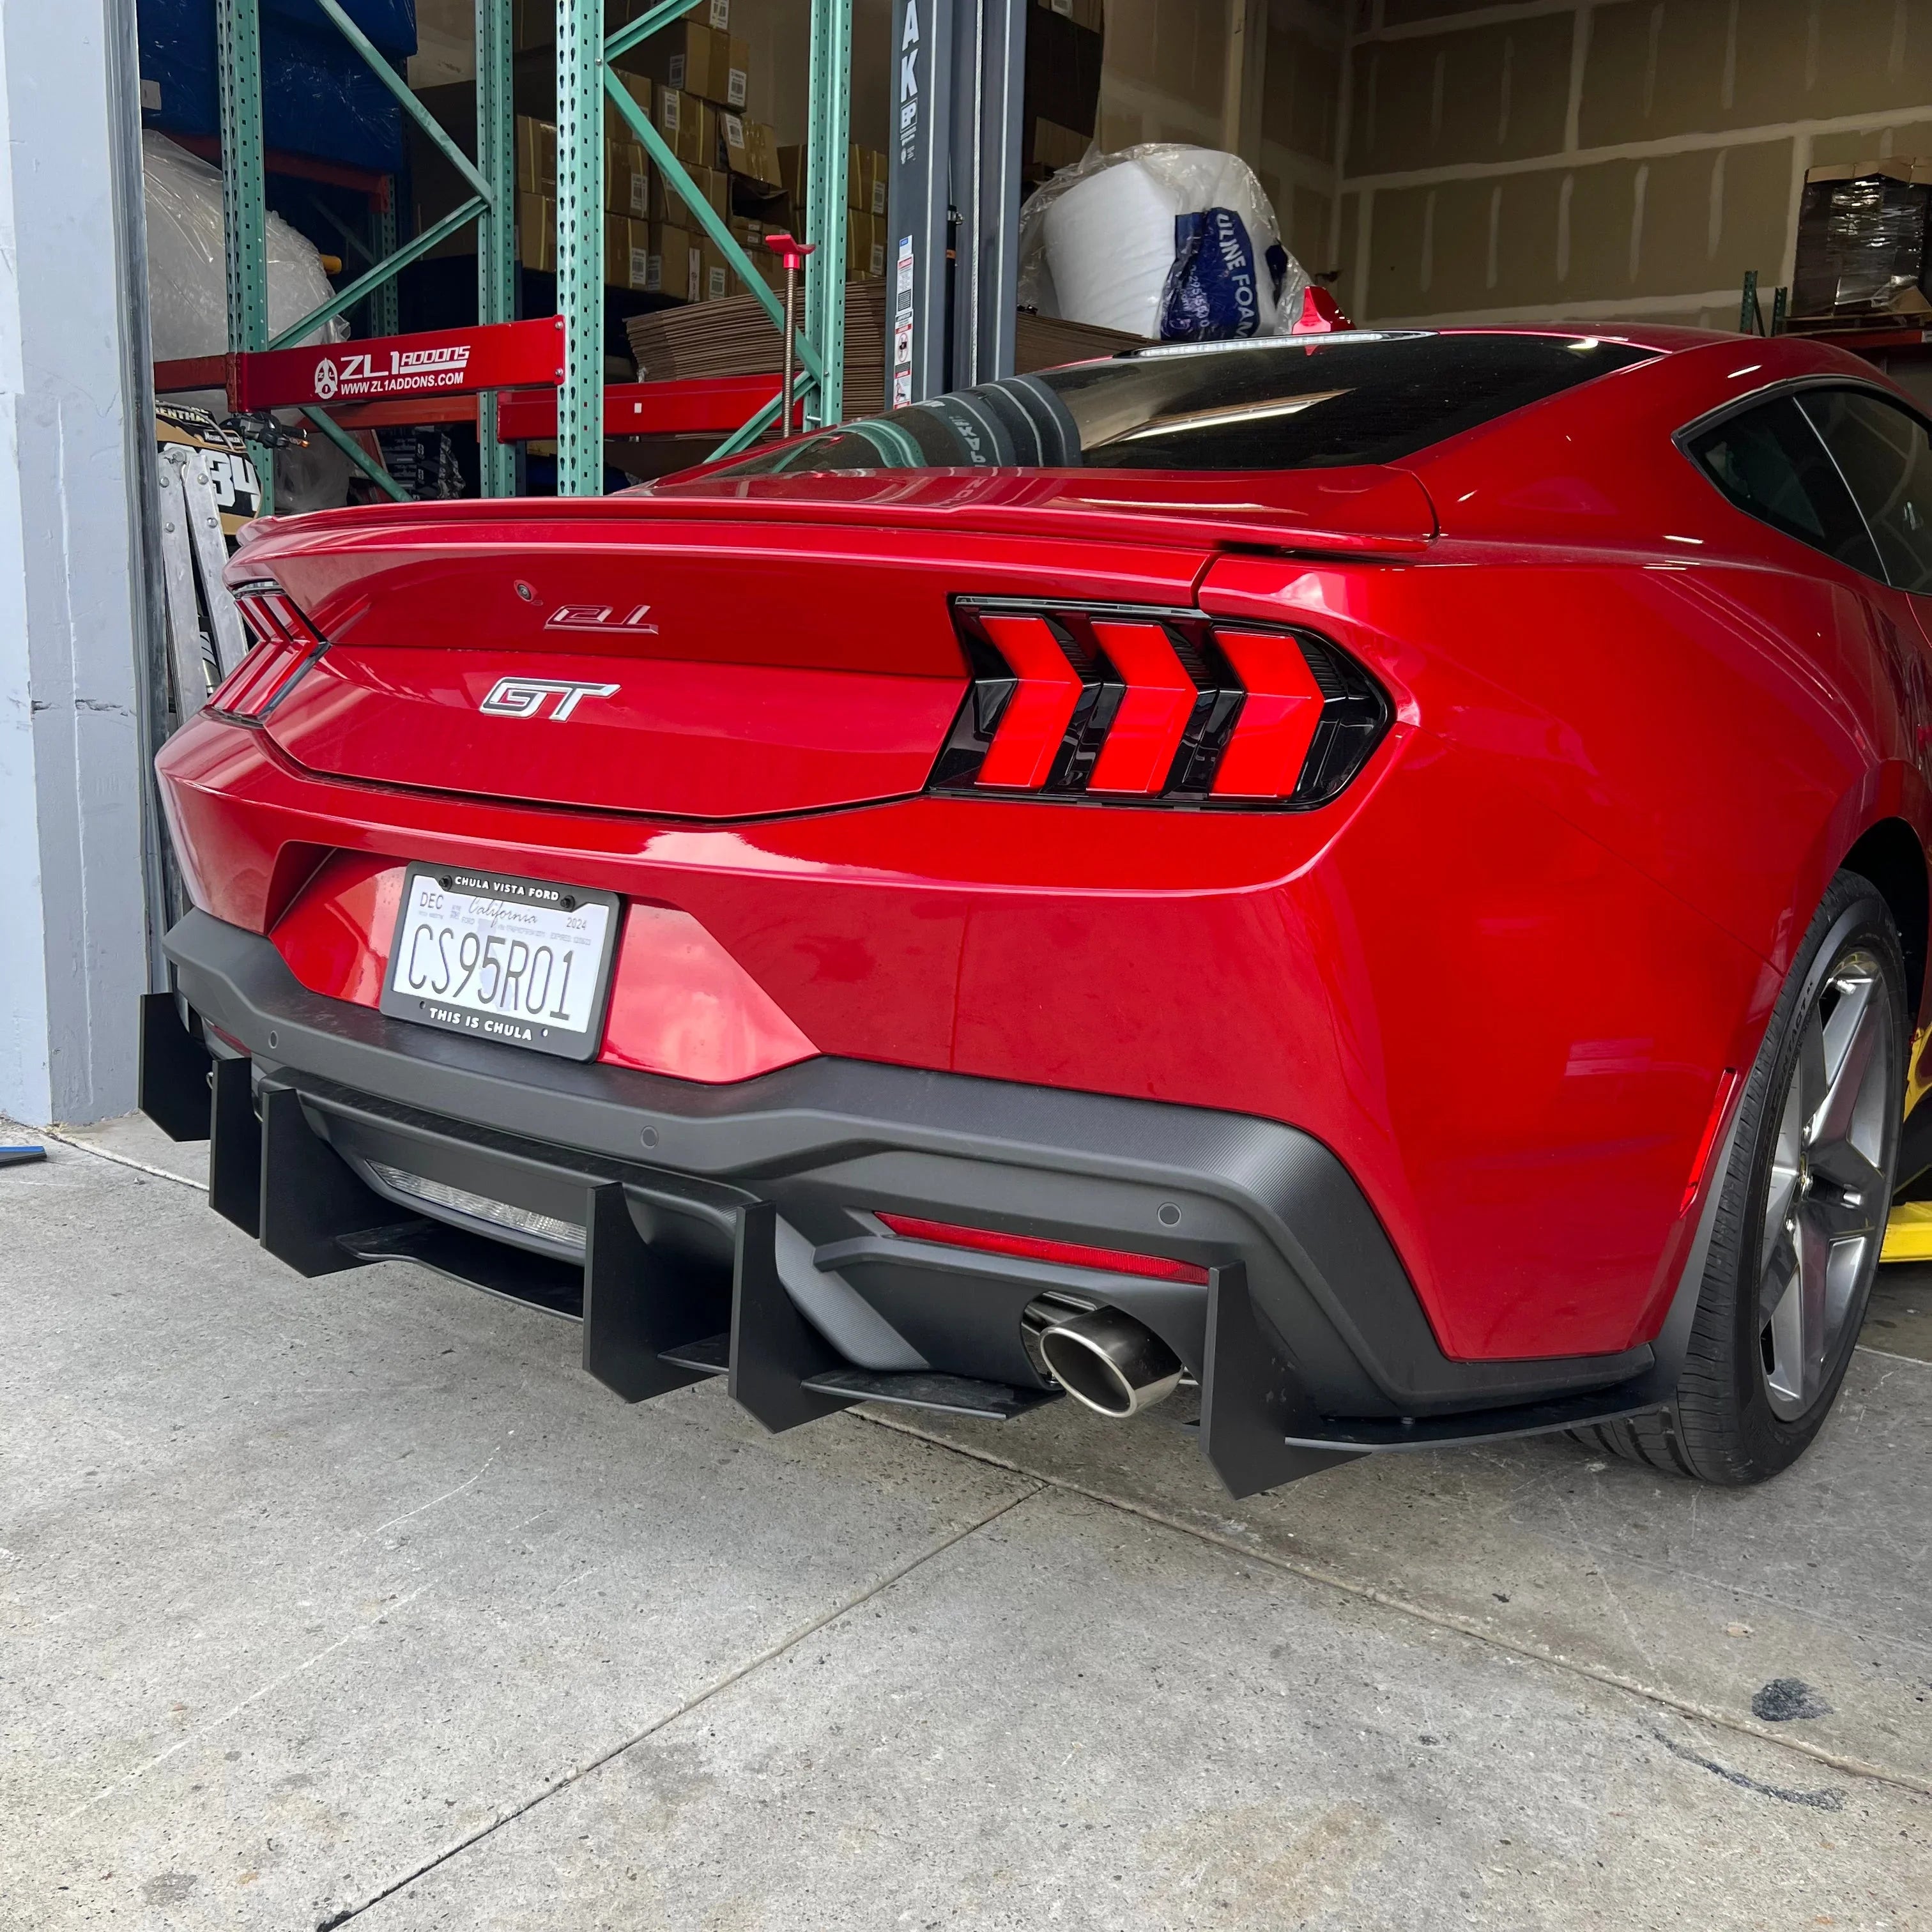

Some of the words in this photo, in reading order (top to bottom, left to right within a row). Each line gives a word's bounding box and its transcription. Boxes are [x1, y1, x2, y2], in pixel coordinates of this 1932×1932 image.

[1216, 213, 1246, 271] ULINE
[479, 676, 622, 722] GT
[454, 877, 490, 890] CHULA
[493, 882, 525, 895] VISTA
[528, 888, 560, 901] FORD
[420, 892, 444, 910] DEC
[468, 896, 538, 928] California
[566, 917, 587, 931] 2024
[409, 924, 573, 1021] CS95R01
[429, 1008, 461, 1024] THIS
[465, 1016, 479, 1029] IS
[484, 1020, 532, 1041] CHULA
